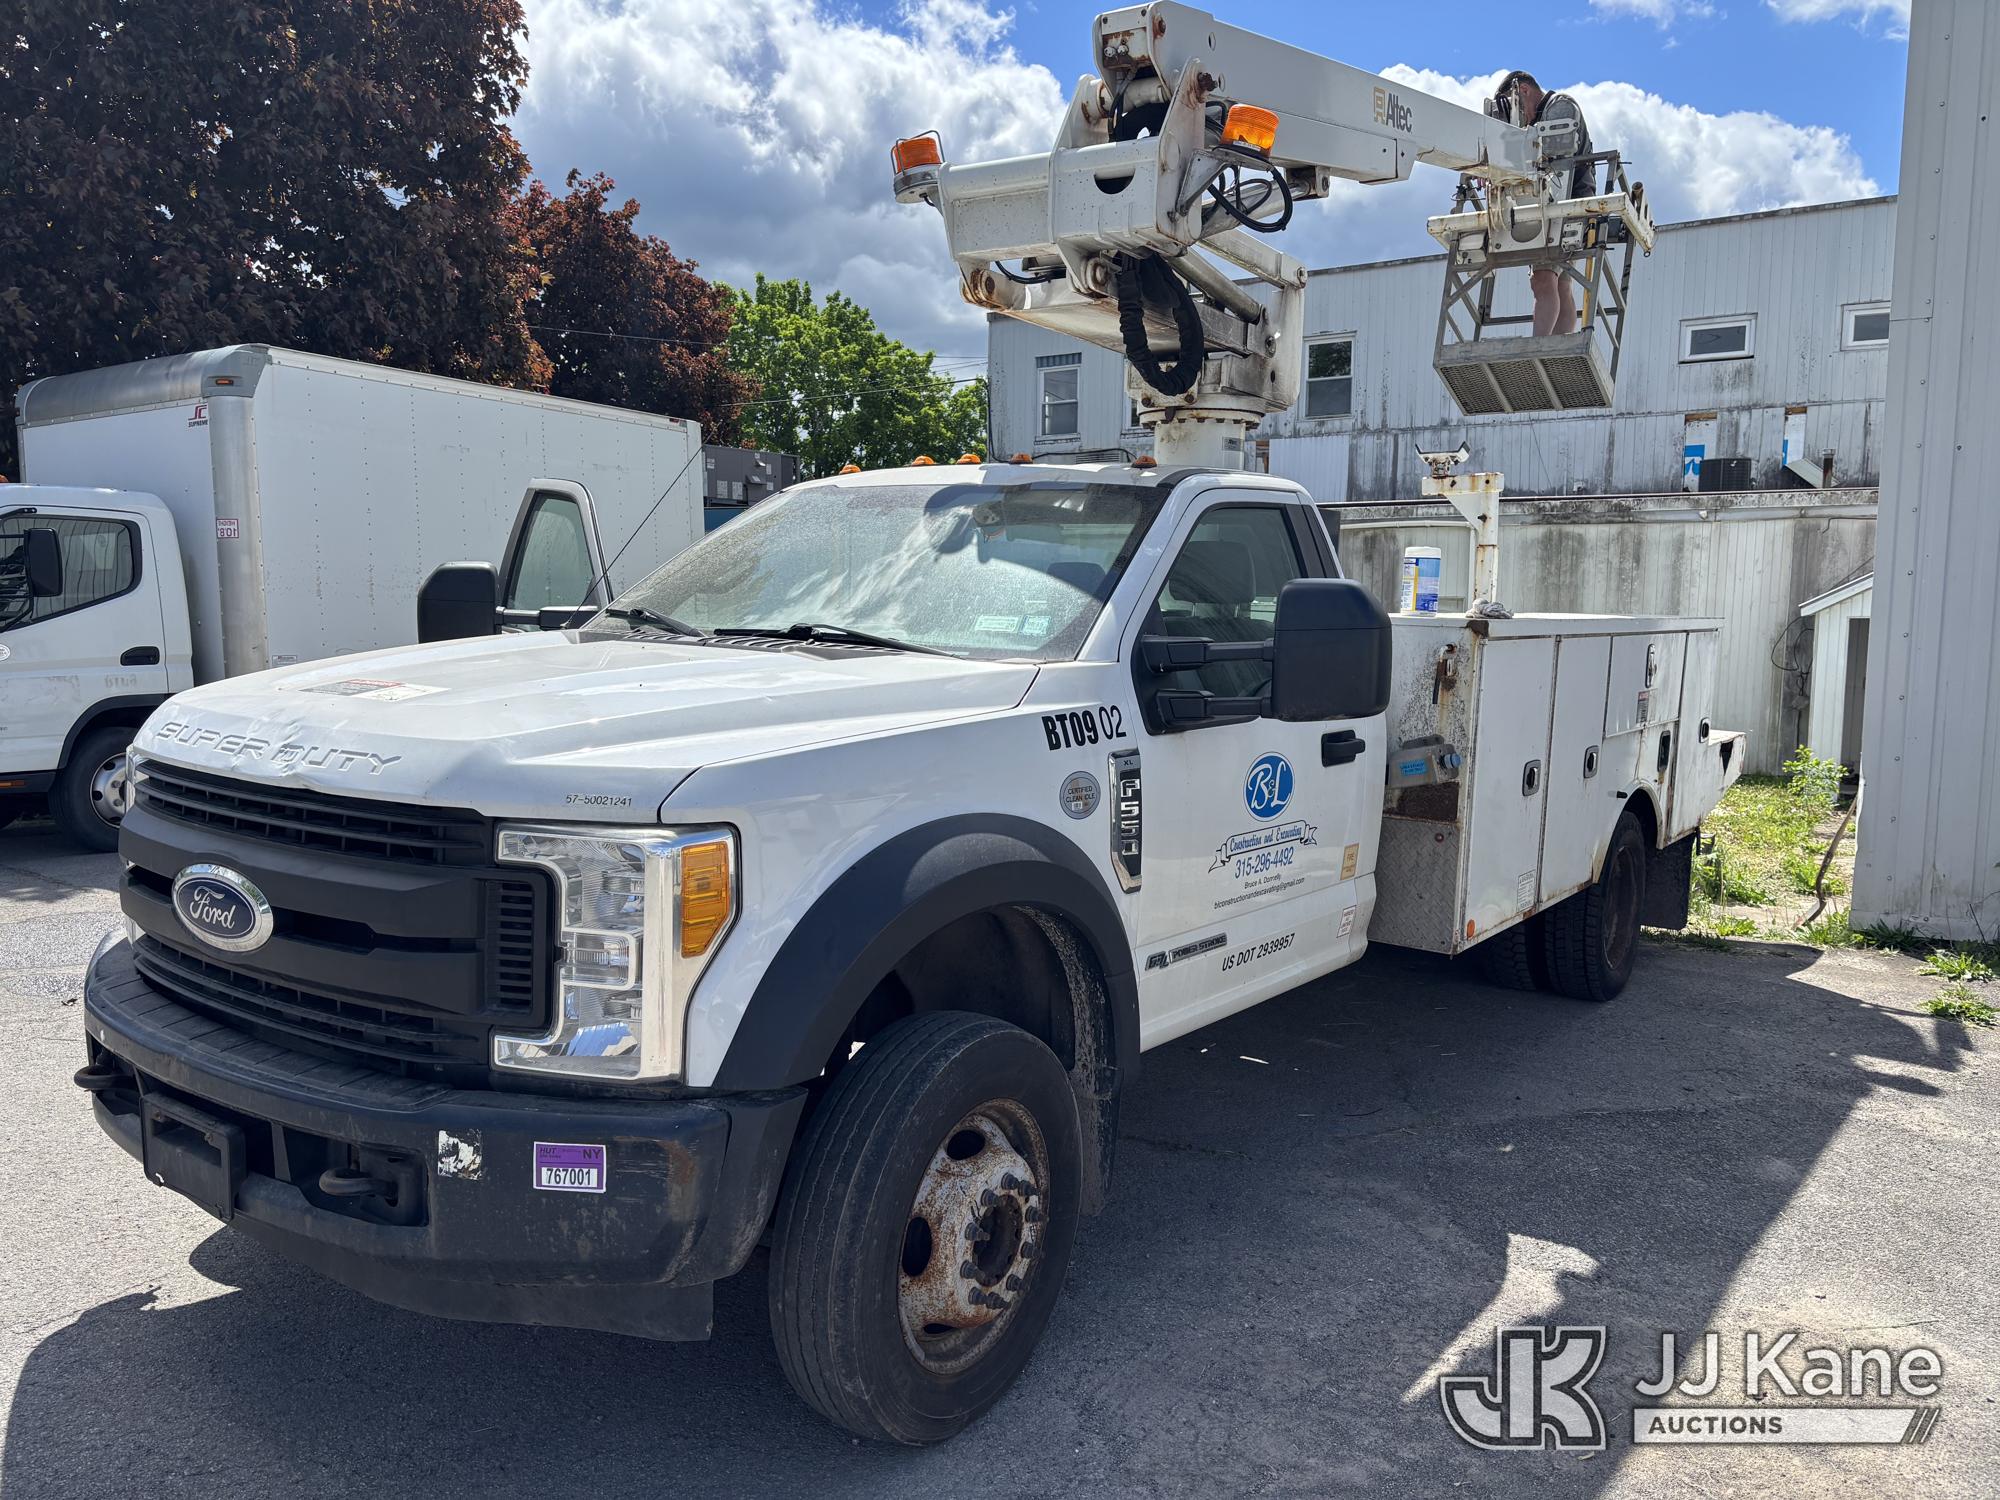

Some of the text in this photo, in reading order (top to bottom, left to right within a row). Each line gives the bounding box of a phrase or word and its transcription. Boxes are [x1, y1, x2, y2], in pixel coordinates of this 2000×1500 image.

[1386, 93, 1412, 133] Altec
[1042, 705, 1127, 751] BT09 02
[156, 721, 402, 776] SUPER DUTY
[1065, 795, 1083, 803] CLEAN
[1068, 785, 1093, 795] CERTIFIED
[1247, 760, 1291, 810] B&L
[566, 794, 632, 807] 57-50021241
[1230, 834, 1262, 853] Construction
[1264, 829, 1274, 844] and
[1235, 846, 1294, 879] 315-296-4492
[1244, 880, 1258, 889] Bruce
[189, 885, 236, 929] Ford
[1222, 932, 1295, 972] US DOT 2939957
[583, 1149, 602, 1159] NY
[546, 1168, 591, 1186] 767001
